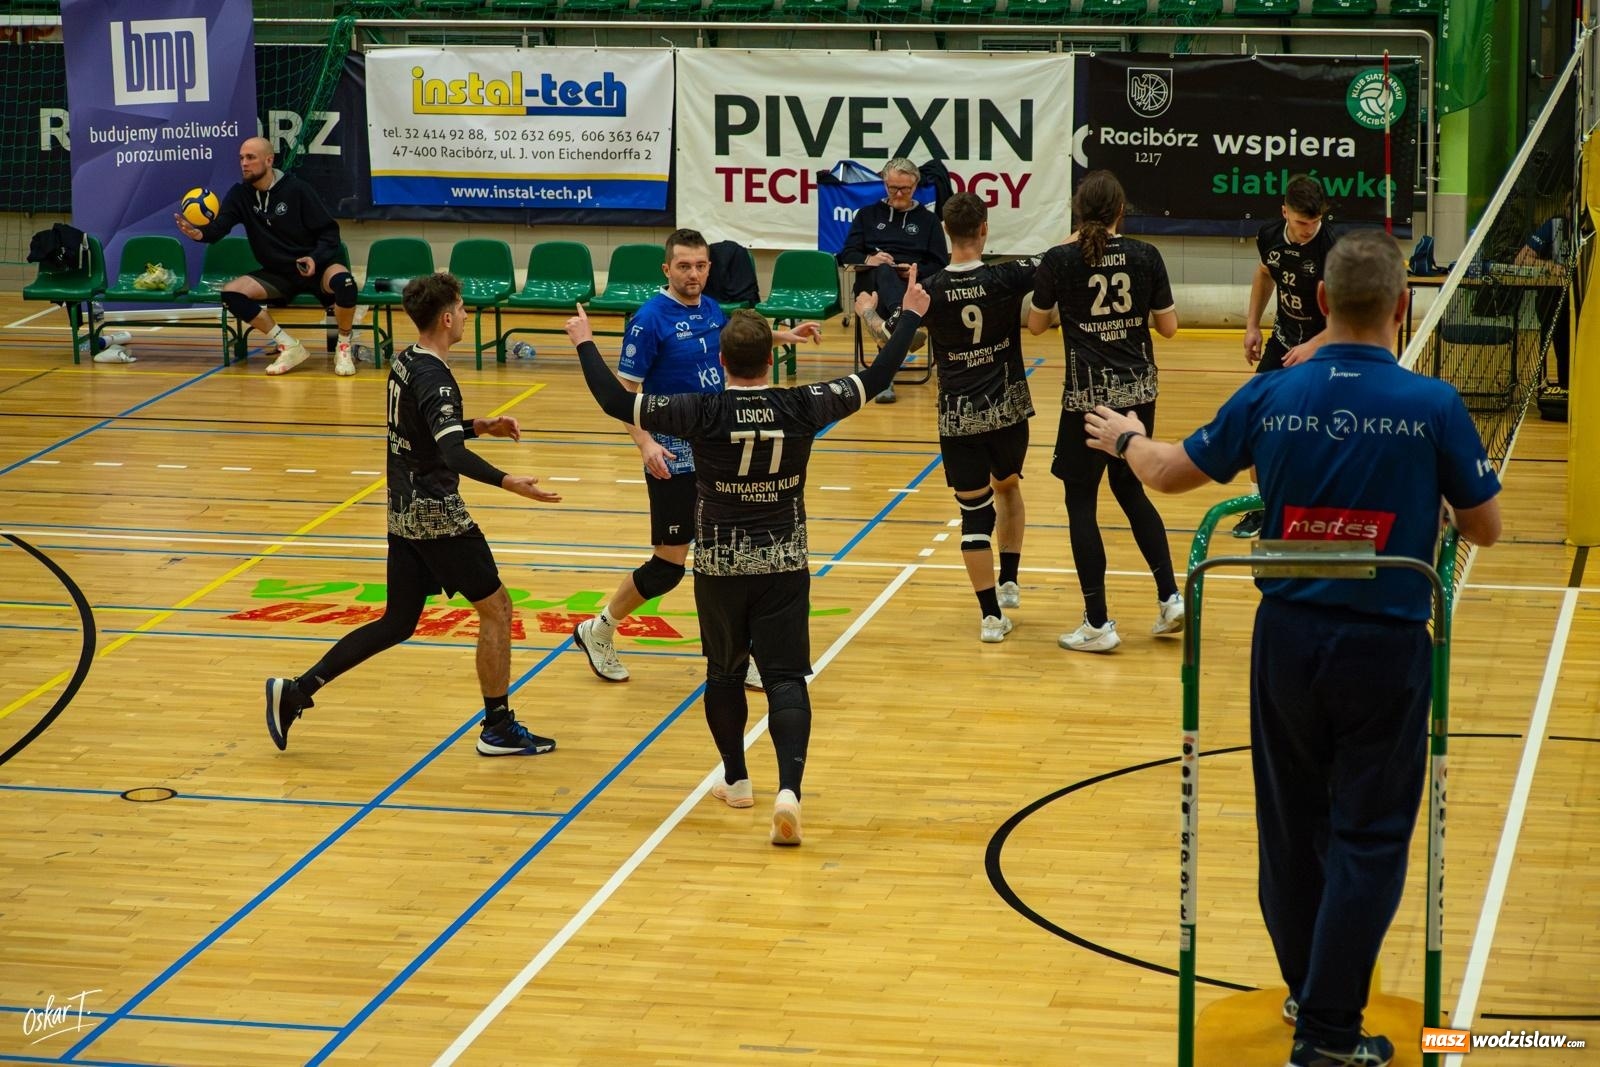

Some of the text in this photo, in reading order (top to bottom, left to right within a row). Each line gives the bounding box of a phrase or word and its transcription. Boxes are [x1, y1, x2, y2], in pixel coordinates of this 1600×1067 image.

[111, 18, 207, 105] bmp
[411, 66, 627, 117] instal-tech
[1351, 78, 1366, 98] KLUB
[714, 94, 1034, 162] PIVEXIN
[1356, 111, 1397, 126] RACIBÓZ
[89, 121, 239, 145] budujemy możliwości
[383, 127, 660, 143] tel. 32 414 92 88, 502 632 695, 606 363 647
[1100, 127, 1199, 148] Racibórz
[392, 145, 652, 160] 47-400 Racibórz, ul. J. von Eichendorffa 2
[1213, 128, 1356, 162] wspiera
[116, 145, 213, 167] porozumienia
[1134, 151, 1162, 167] 1217
[451, 185, 593, 203] www.instal-tech.pl
[714, 166, 1033, 210] TECHGY
[1212, 167, 1397, 204] siatwkę
[1090, 253, 1126, 268] OUCH
[1282, 271, 1296, 287] 32
[944, 284, 987, 303] TATERKA
[1087, 272, 1132, 316] 23
[1280, 290, 1302, 310] KB
[961, 304, 984, 345] 9
[698, 366, 721, 389] KB
[735, 408, 775, 424] LISICKI
[730, 430, 785, 477] 77
[715, 474, 800, 494] SIATKARSKI KLUB
[1287, 517, 1379, 539] martes
